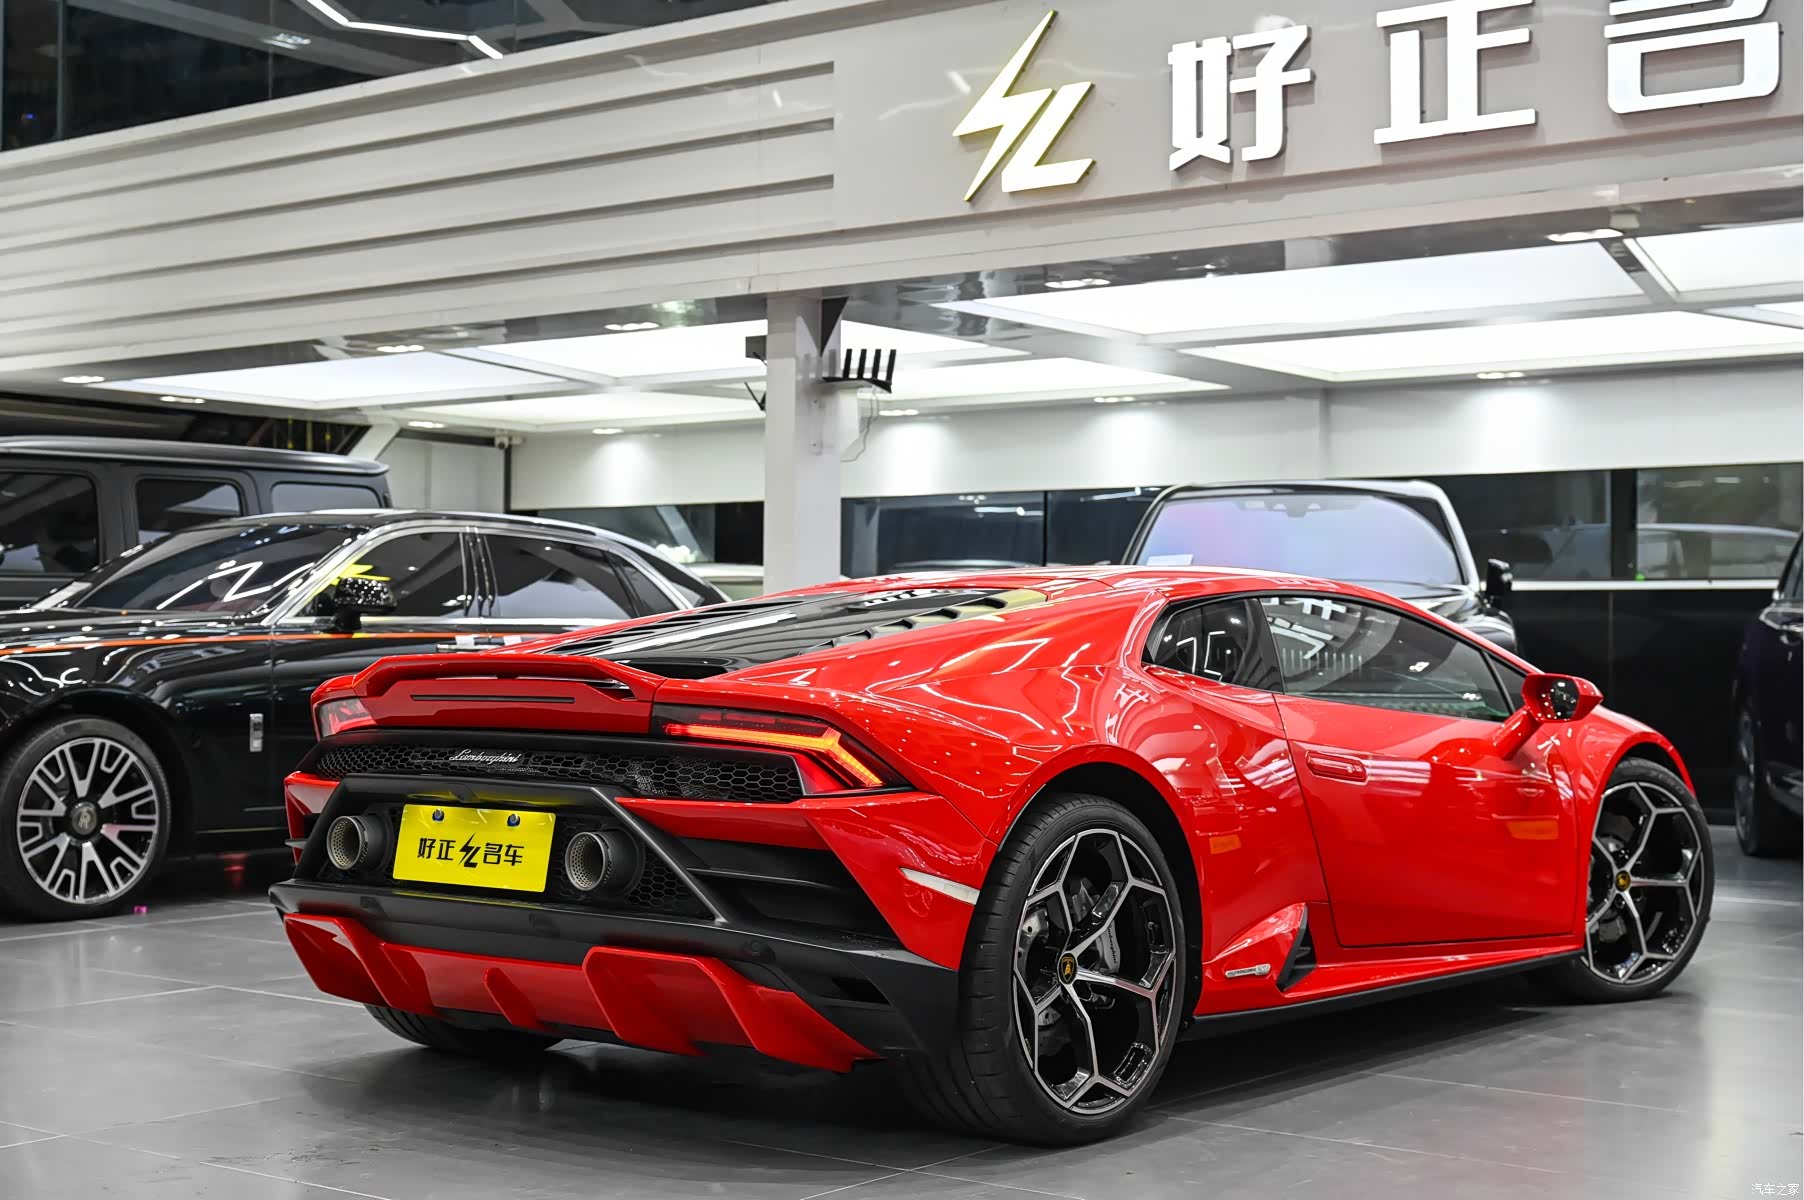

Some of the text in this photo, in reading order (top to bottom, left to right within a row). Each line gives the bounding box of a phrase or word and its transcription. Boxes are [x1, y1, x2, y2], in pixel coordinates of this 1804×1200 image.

[449, 748, 521, 765] Lamborghini
[417, 837, 524, 866] 好正 名车
